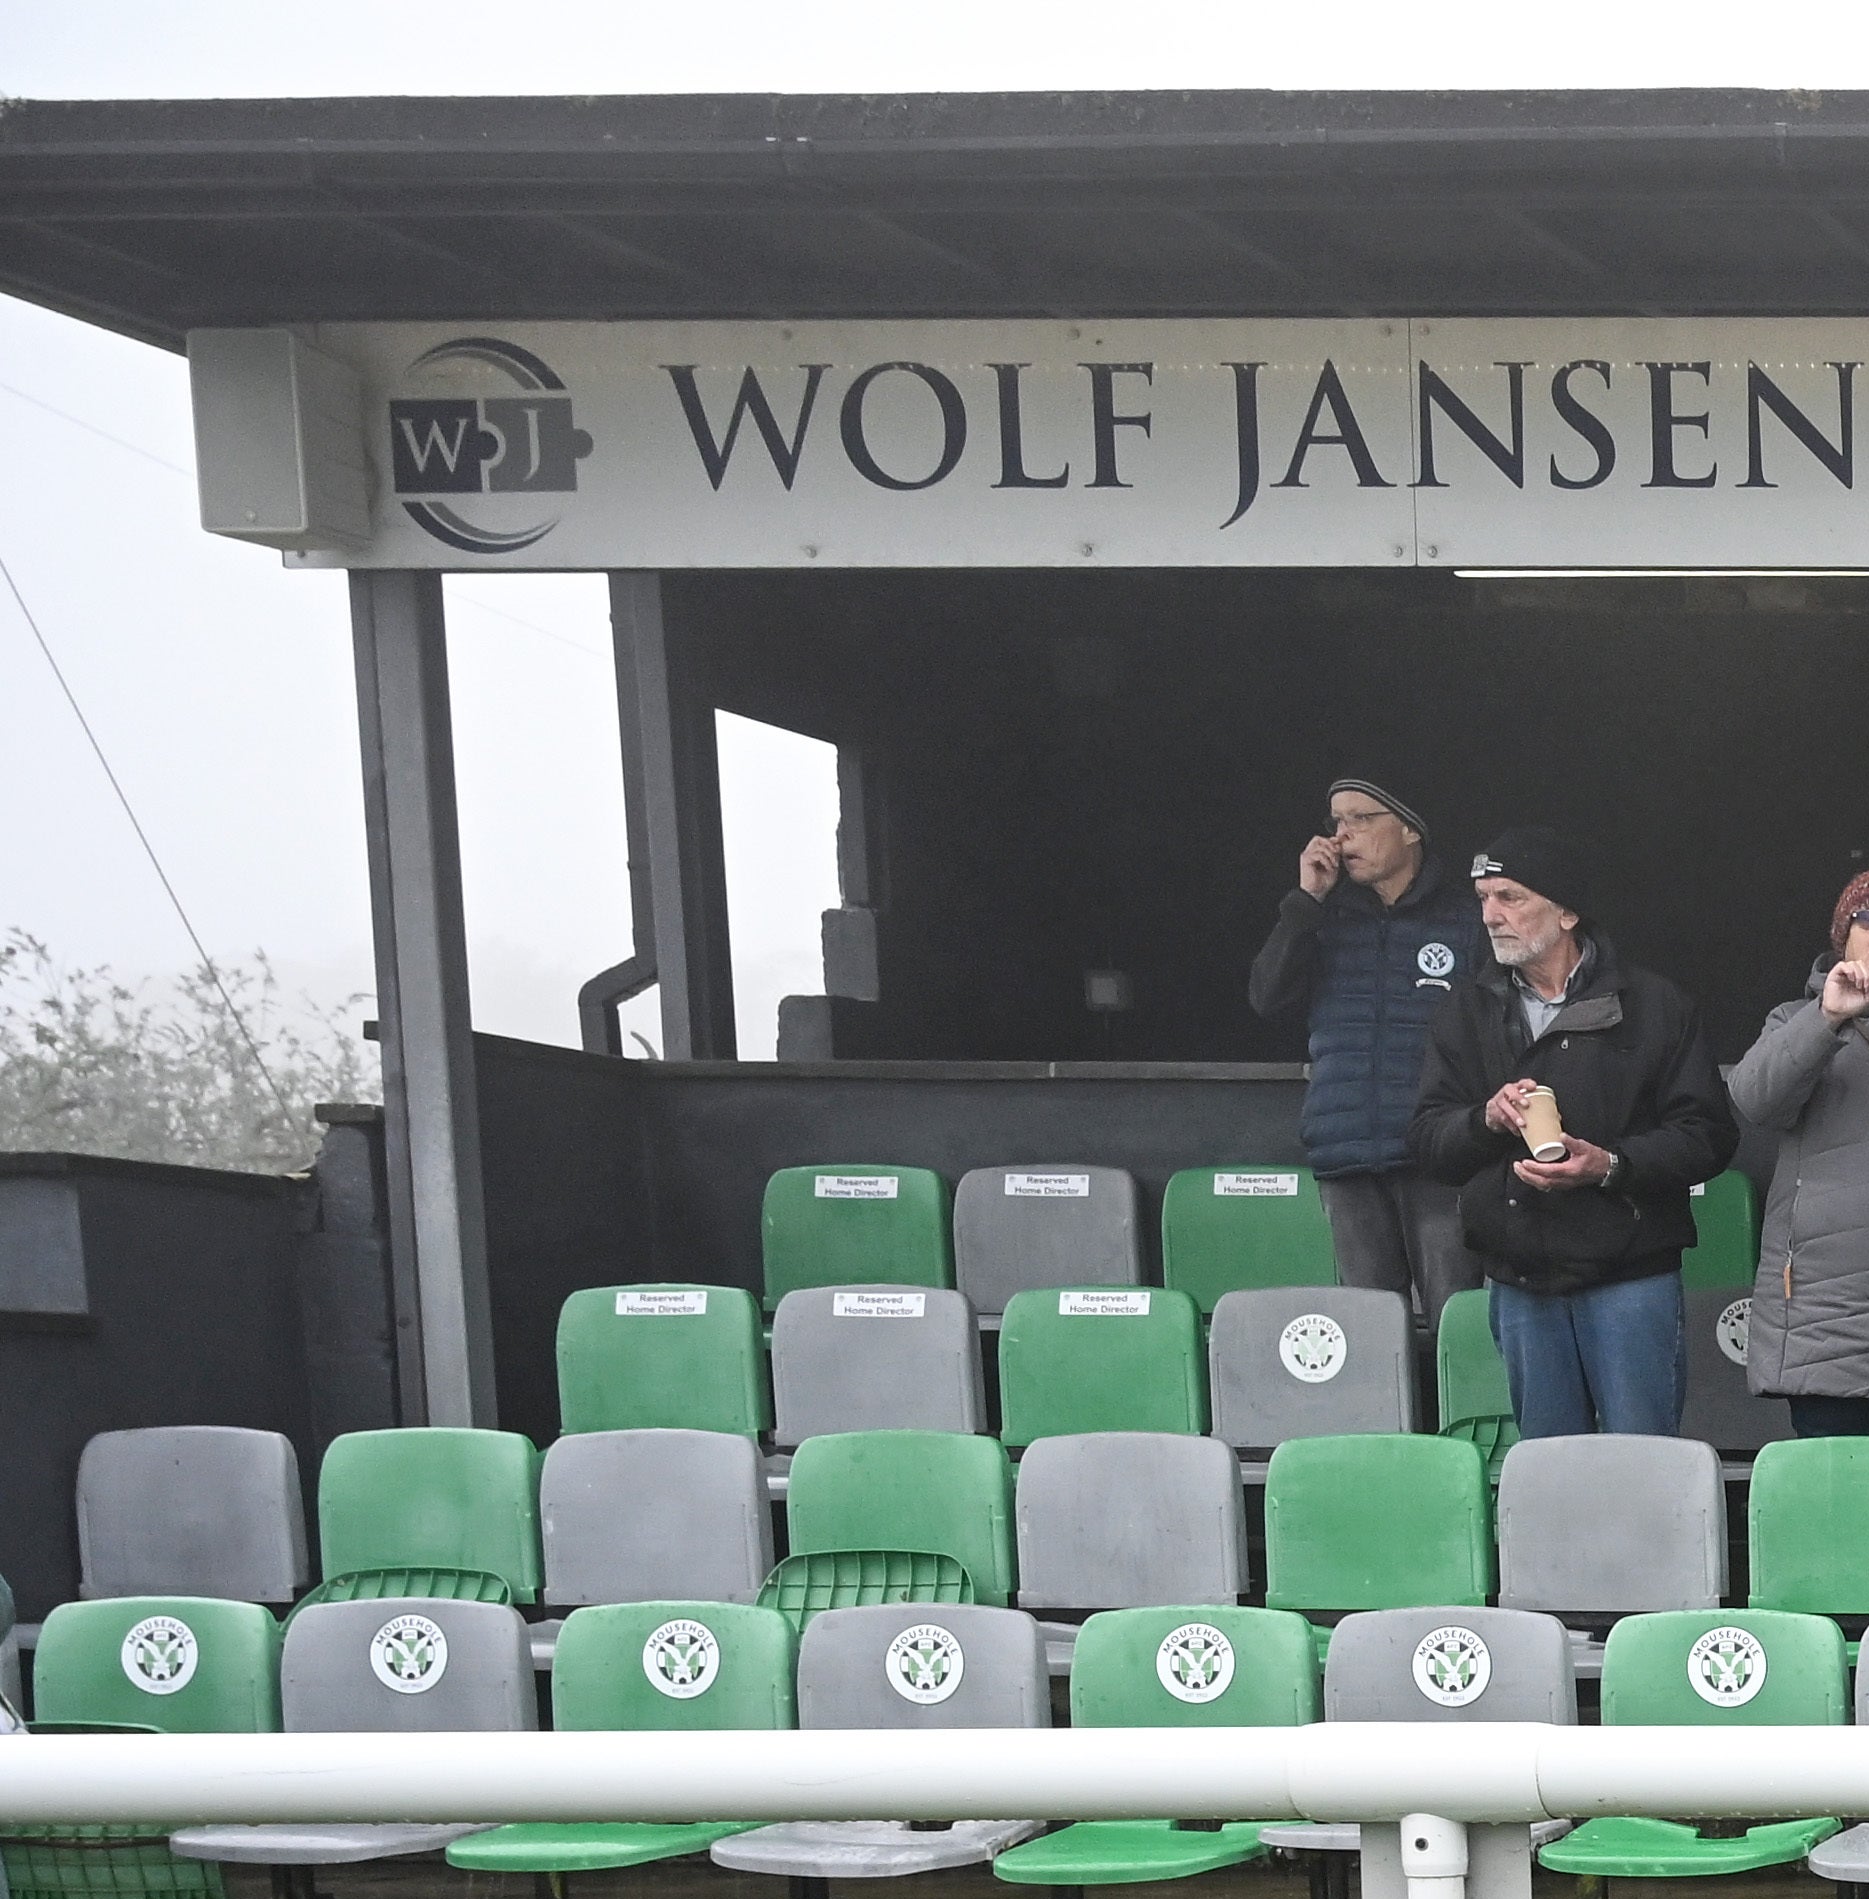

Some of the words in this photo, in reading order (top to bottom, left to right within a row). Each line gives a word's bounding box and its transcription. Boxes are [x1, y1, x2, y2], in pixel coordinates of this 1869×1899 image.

[660, 362, 1155, 491] WOLF
[1219, 361, 1862, 530] JANSEN
[836, 1178, 879, 1186] Reserved
[1014, 1186, 1042, 1195] Home
[1044, 1186, 1080, 1195] Director
[1025, 1176, 1069, 1185] Reserved
[1223, 1186, 1250, 1194] Home
[1252, 1186, 1288, 1194] Director
[1235, 1176, 1278, 1184] Reserved
[824, 1188, 852, 1197] Home
[853, 1188, 889, 1197] Director
[1069, 1305, 1098, 1314] Home
[1100, 1305, 1139, 1314] Director
[1082, 1294, 1128, 1302] Reserved
[1284, 1317, 1342, 1341] MOUSEHOLE
[127, 1618, 193, 1647] MOUSEHOLE
[375, 1617, 442, 1645] MOUSEHOLE
[648, 1622, 714, 1650] MOUSEHOLE
[892, 1627, 958, 1656] MOUSEHOLE
[1162, 1626, 1230, 1654] MOUSEHOLE
[1417, 1629, 1485, 1658] MOUSEHOLE
[1692, 1629, 1761, 1658] MOUSEHOLE
